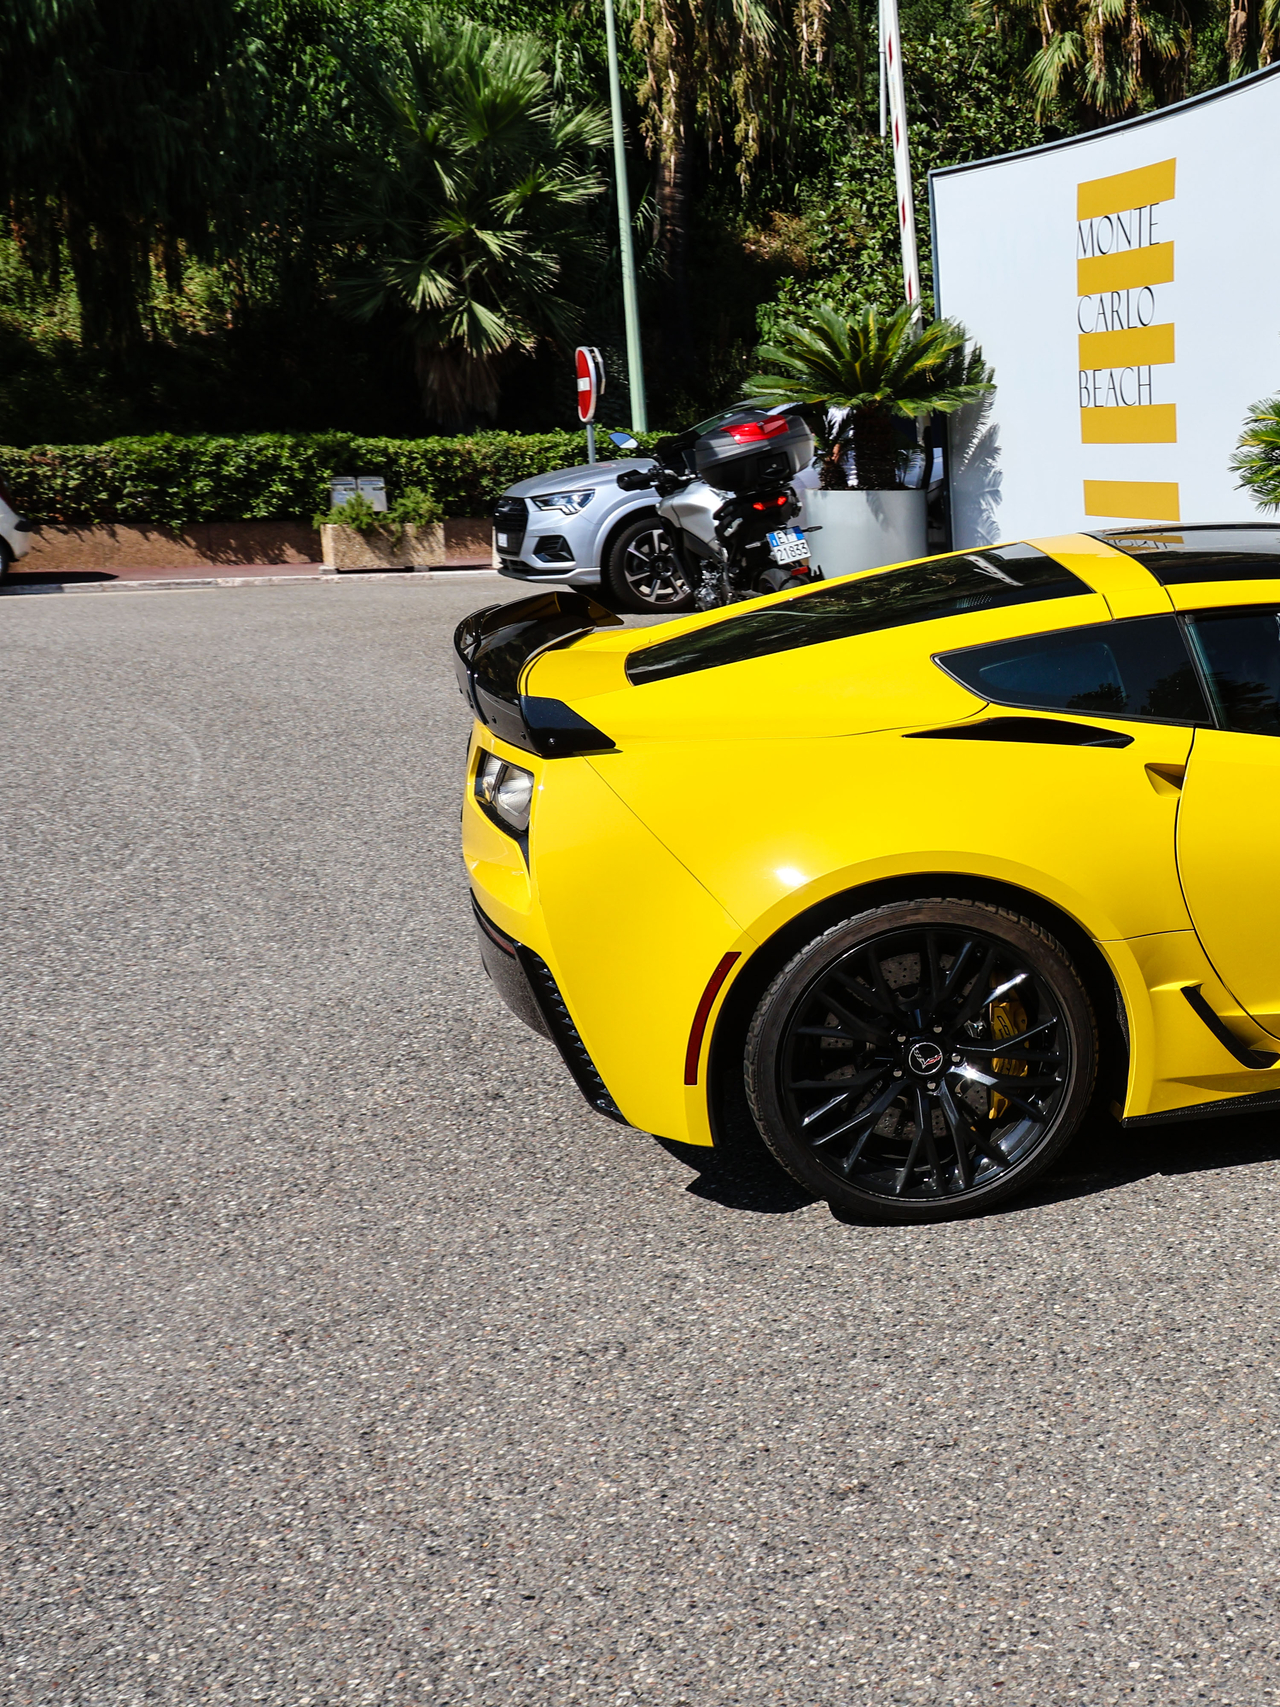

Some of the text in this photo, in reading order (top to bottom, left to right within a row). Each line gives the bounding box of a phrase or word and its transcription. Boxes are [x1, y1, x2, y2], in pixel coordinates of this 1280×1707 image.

[1076, 202, 1160, 258] MONTE
[1077, 286, 1155, 334] CARLO
[1079, 365, 1152, 408] BEACH
[776, 542, 808, 561] 21833
